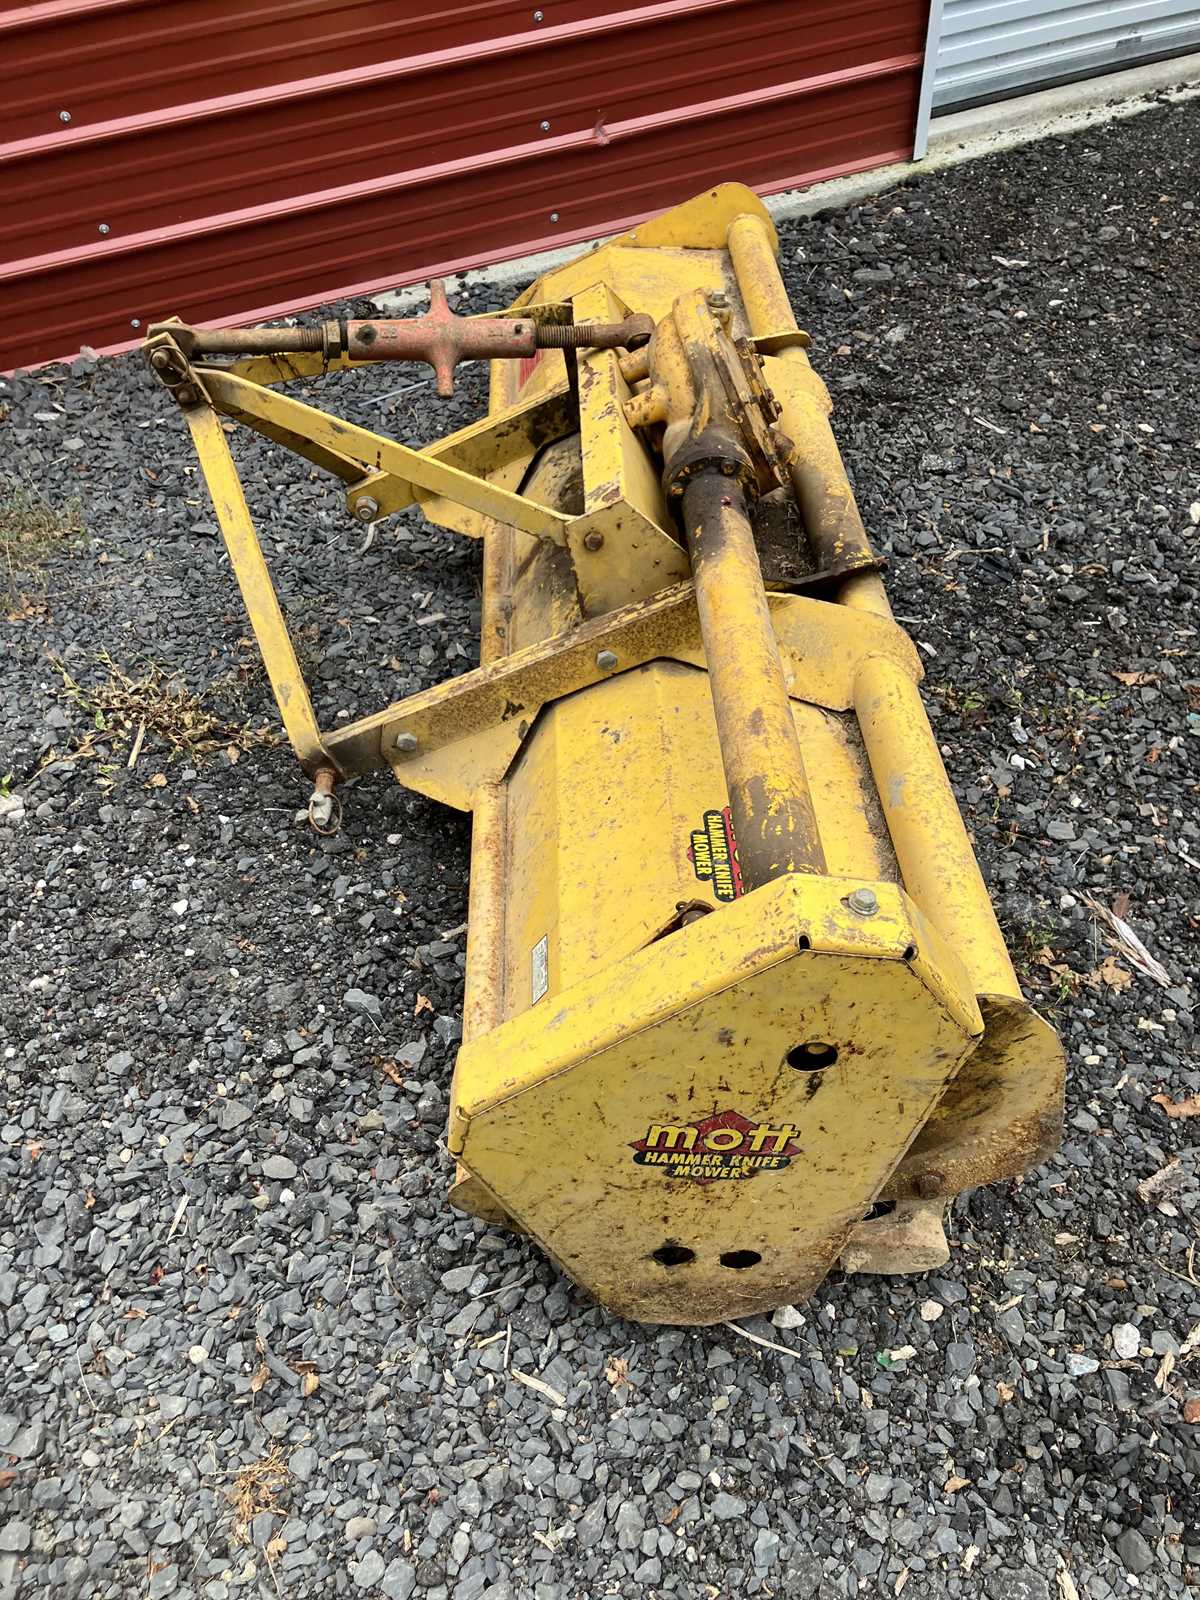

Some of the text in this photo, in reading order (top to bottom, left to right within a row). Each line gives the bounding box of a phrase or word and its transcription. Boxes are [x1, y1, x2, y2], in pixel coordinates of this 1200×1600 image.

[693, 834, 713, 875] MOWER
[707, 815, 734, 896] HAMMER KNIFE
[644, 1151, 781, 1168] HAMMER KNIFE
[673, 1165, 741, 1179] MOWER
